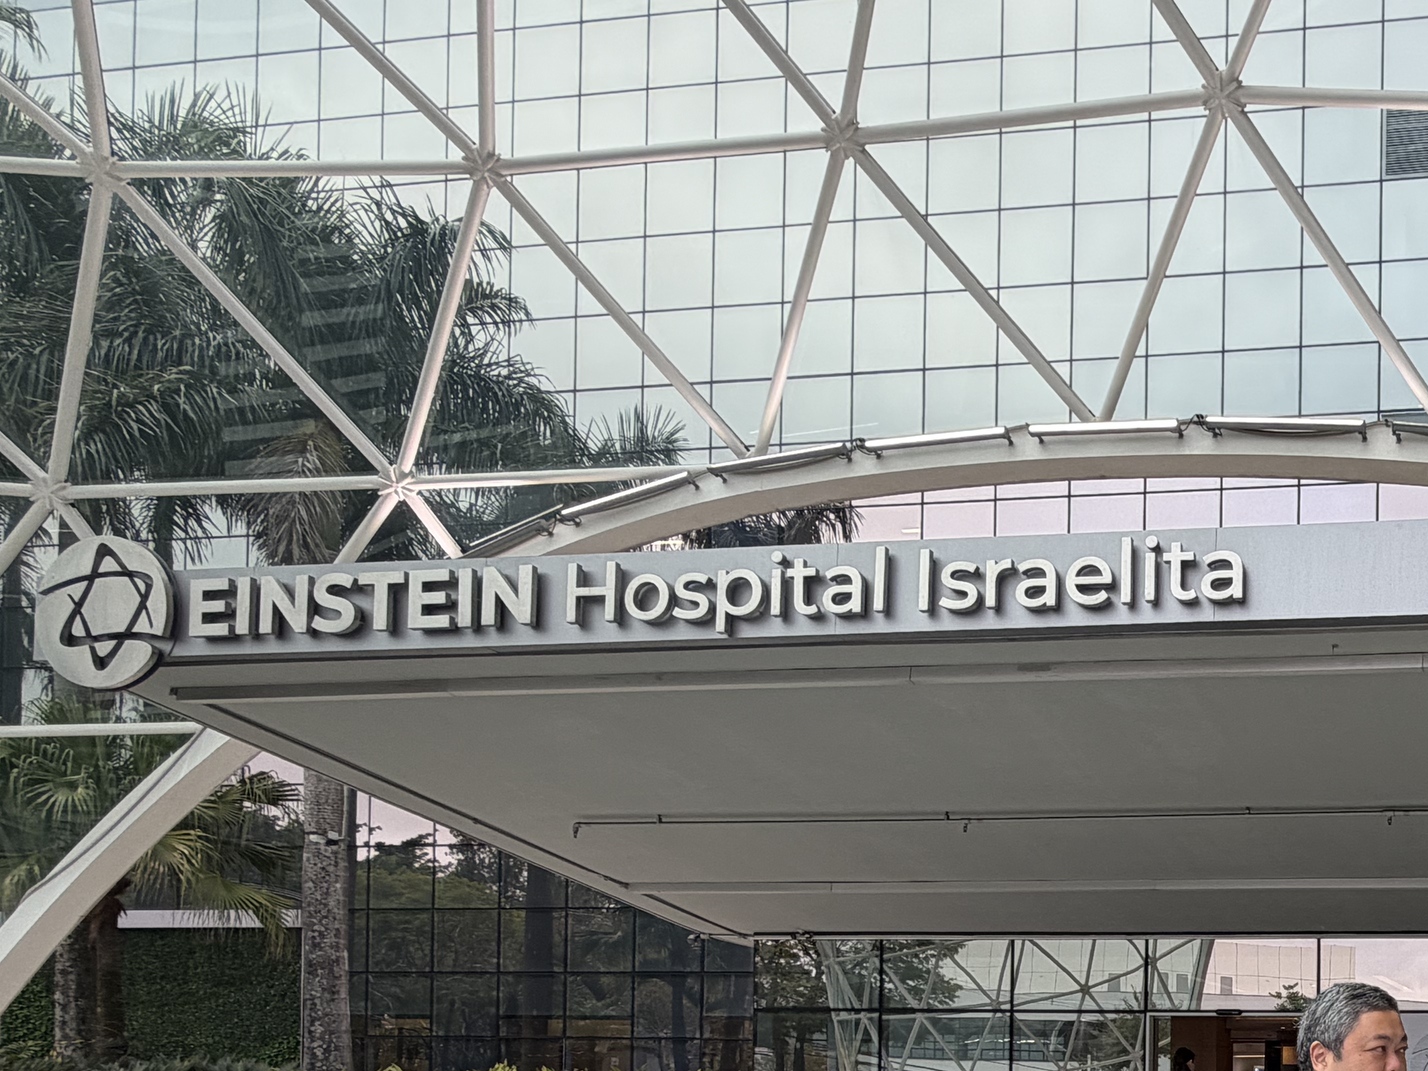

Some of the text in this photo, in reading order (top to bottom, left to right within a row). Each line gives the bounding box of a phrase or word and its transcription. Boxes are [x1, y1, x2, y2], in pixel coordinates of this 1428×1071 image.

[188, 535, 1246, 638] EINSTEIN Hospital Israelita
